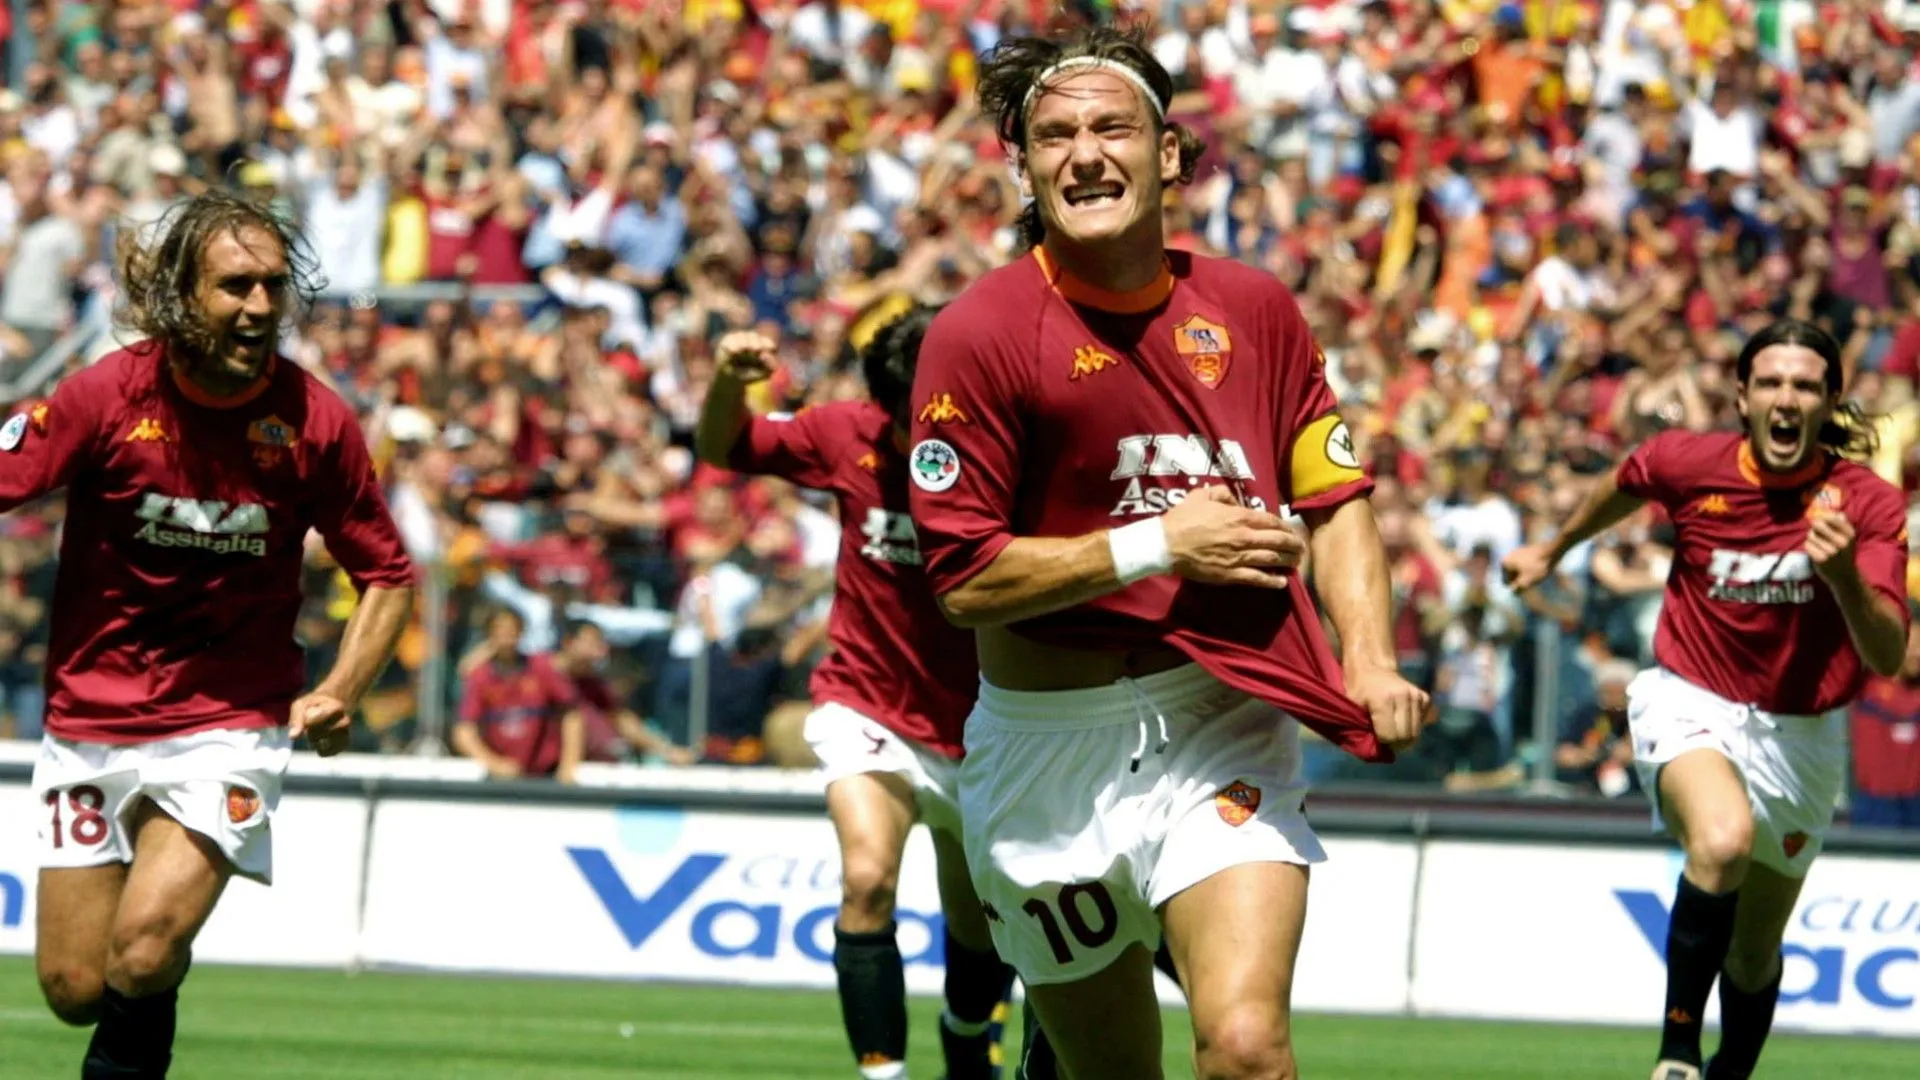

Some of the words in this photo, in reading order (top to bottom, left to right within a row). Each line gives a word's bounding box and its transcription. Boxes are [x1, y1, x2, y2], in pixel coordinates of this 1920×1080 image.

[1110, 433, 1256, 482] INA
[133, 520, 267, 557] Assitalia
[46, 784, 108, 849] 18
[1022, 880, 1118, 964] 10
[1800, 895, 1920, 933] CLU
